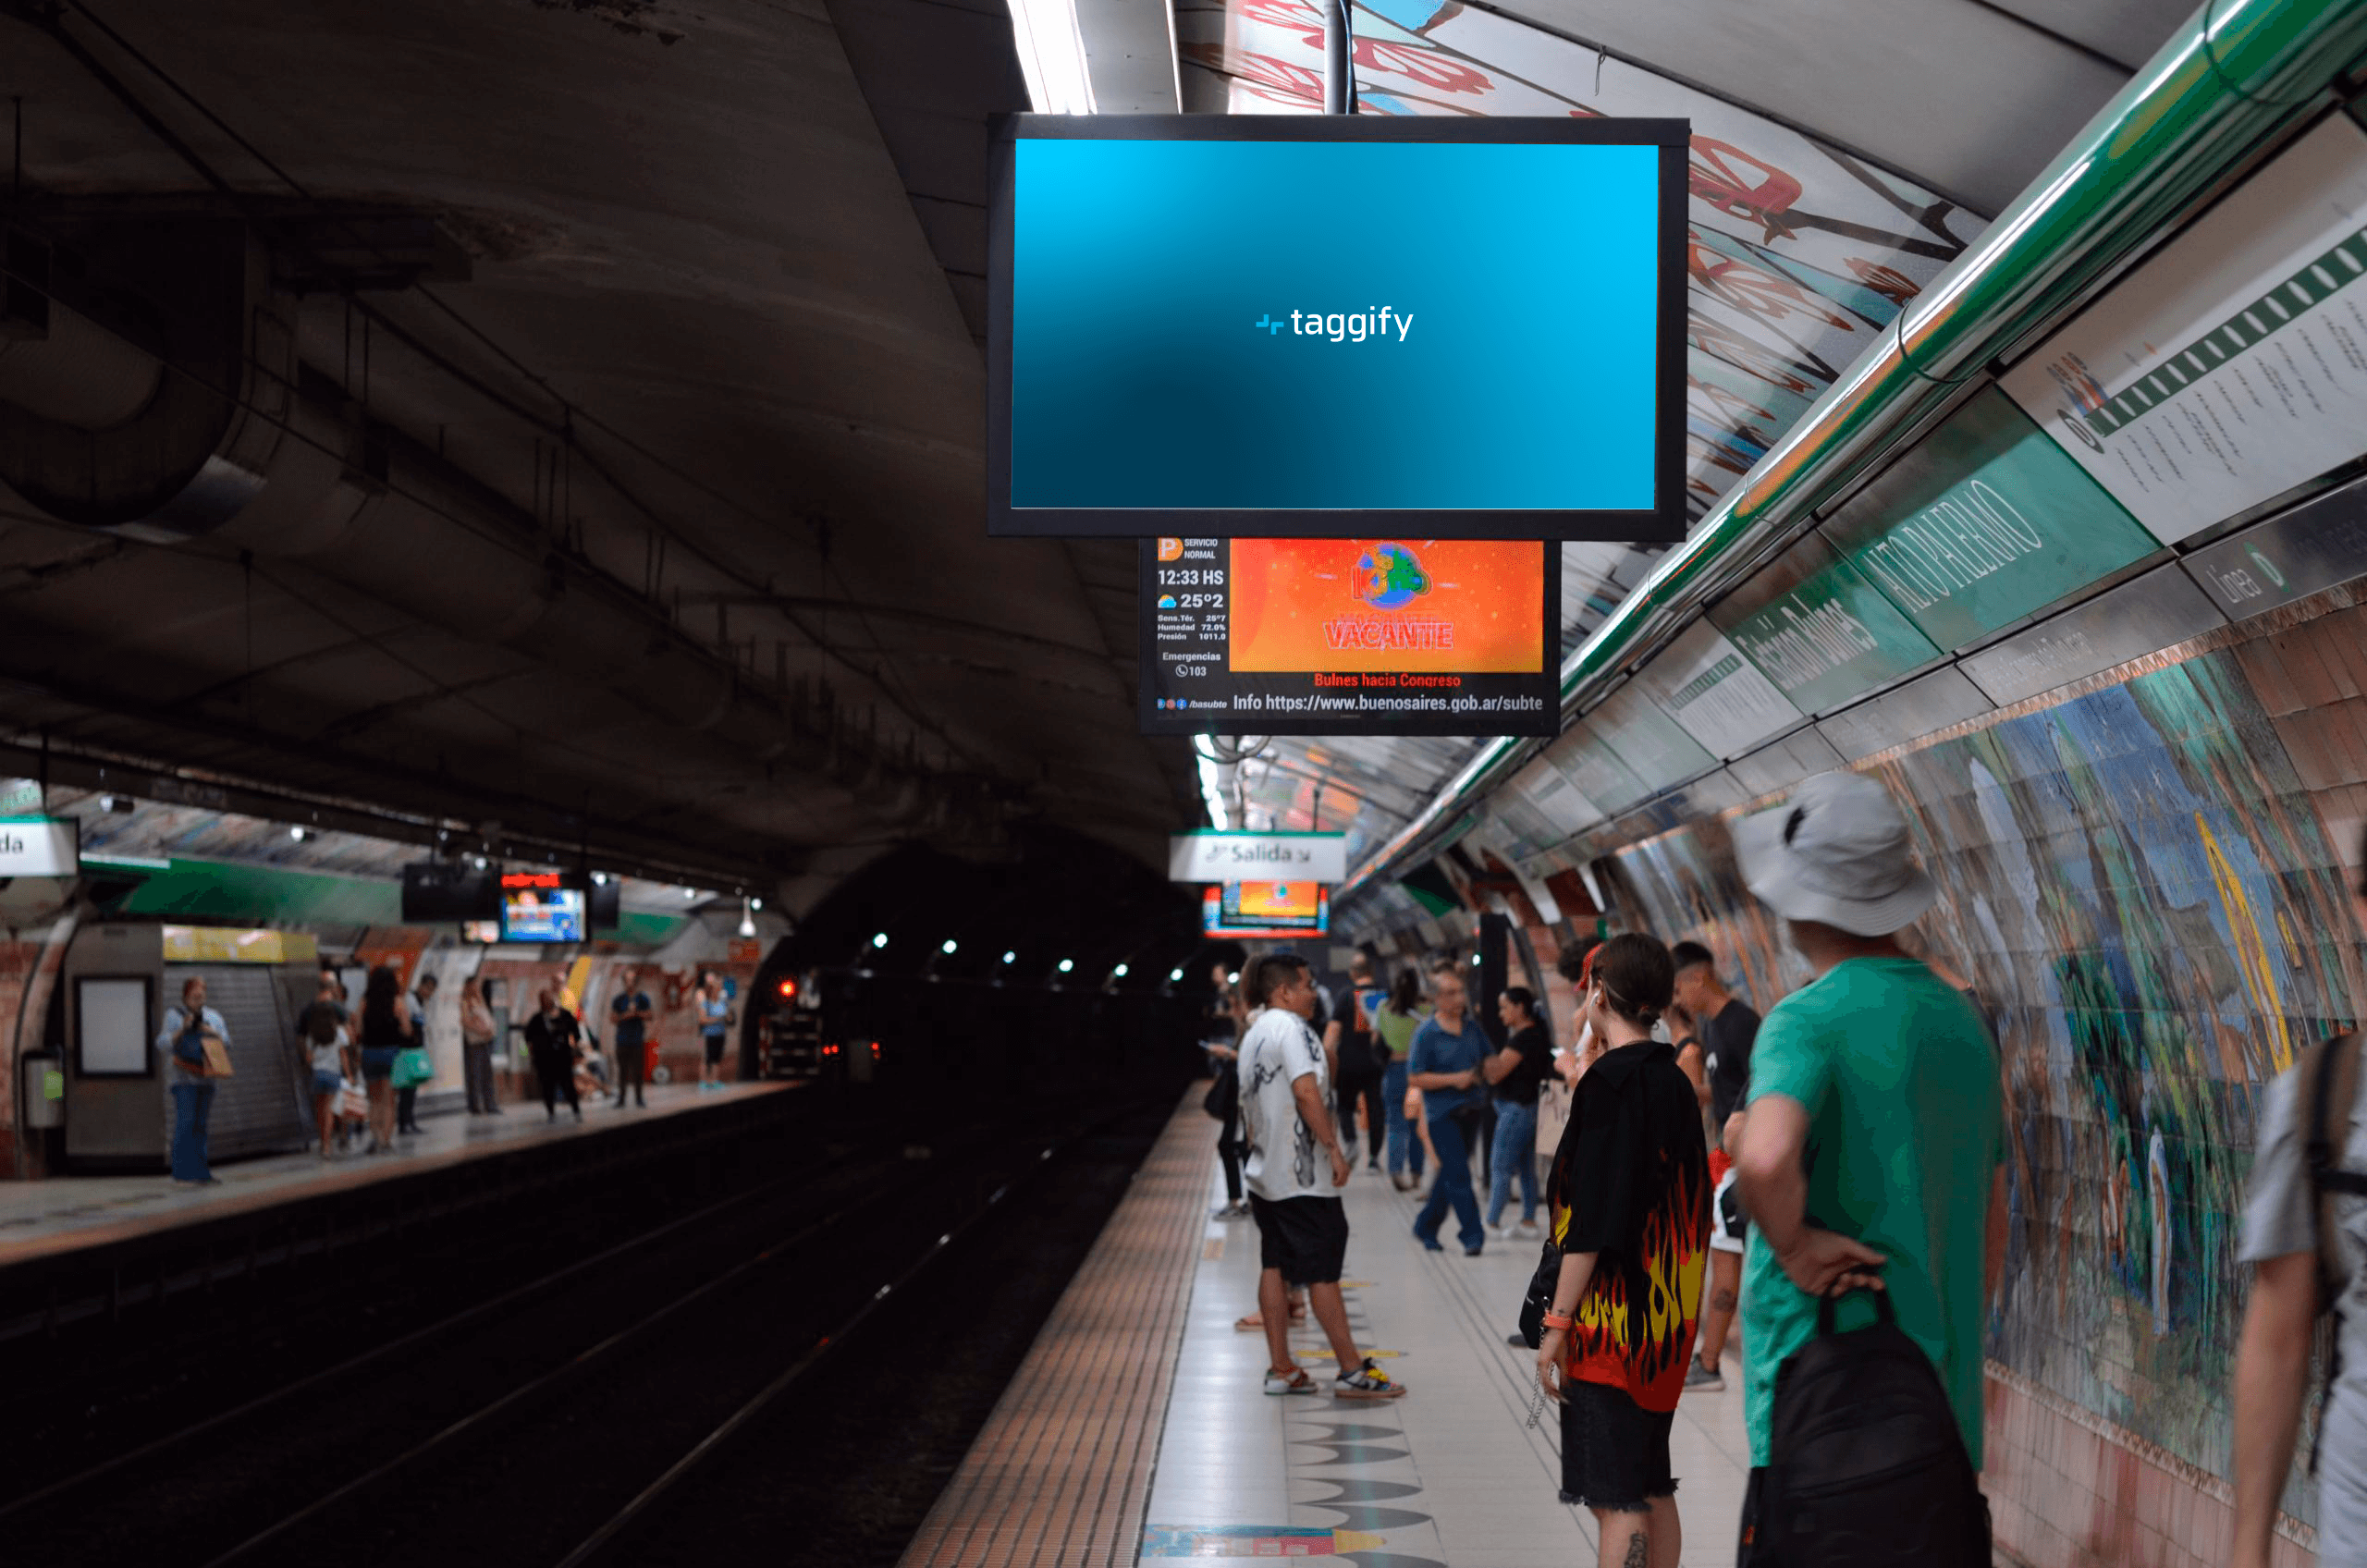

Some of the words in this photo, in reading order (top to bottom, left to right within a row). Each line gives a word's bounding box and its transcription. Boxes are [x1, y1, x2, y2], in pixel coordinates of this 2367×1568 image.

[1291, 306, 1414, 342] taggify
[1184, 538, 1218, 547] SERVICIO
[1901, 480, 2042, 588] PALERMO
[1184, 550, 1216, 559] NORMAL
[1159, 570, 1199, 585] 12:33
[1203, 570, 1224, 585] HS
[1862, 535, 1949, 613] ALTO
[2206, 564, 2263, 603] Línea
[1158, 623, 1196, 631] Humedad
[1201, 623, 1226, 631] 72.0%
[1322, 620, 1454, 651] VACANTE
[1779, 593, 1877, 666] Bulnes
[1158, 632, 1187, 641] Presión
[1162, 652, 1221, 662] Emergencias
[1189, 666, 1207, 677] 103
[1314, 672, 1358, 687] Bulnes
[1400, 673, 1462, 688] Congreso
[1233, 693, 1262, 710] Info
[1266, 693, 1543, 713] https://www.buenosaires.gob.ar/subte
[1233, 844, 1293, 863] Salida
